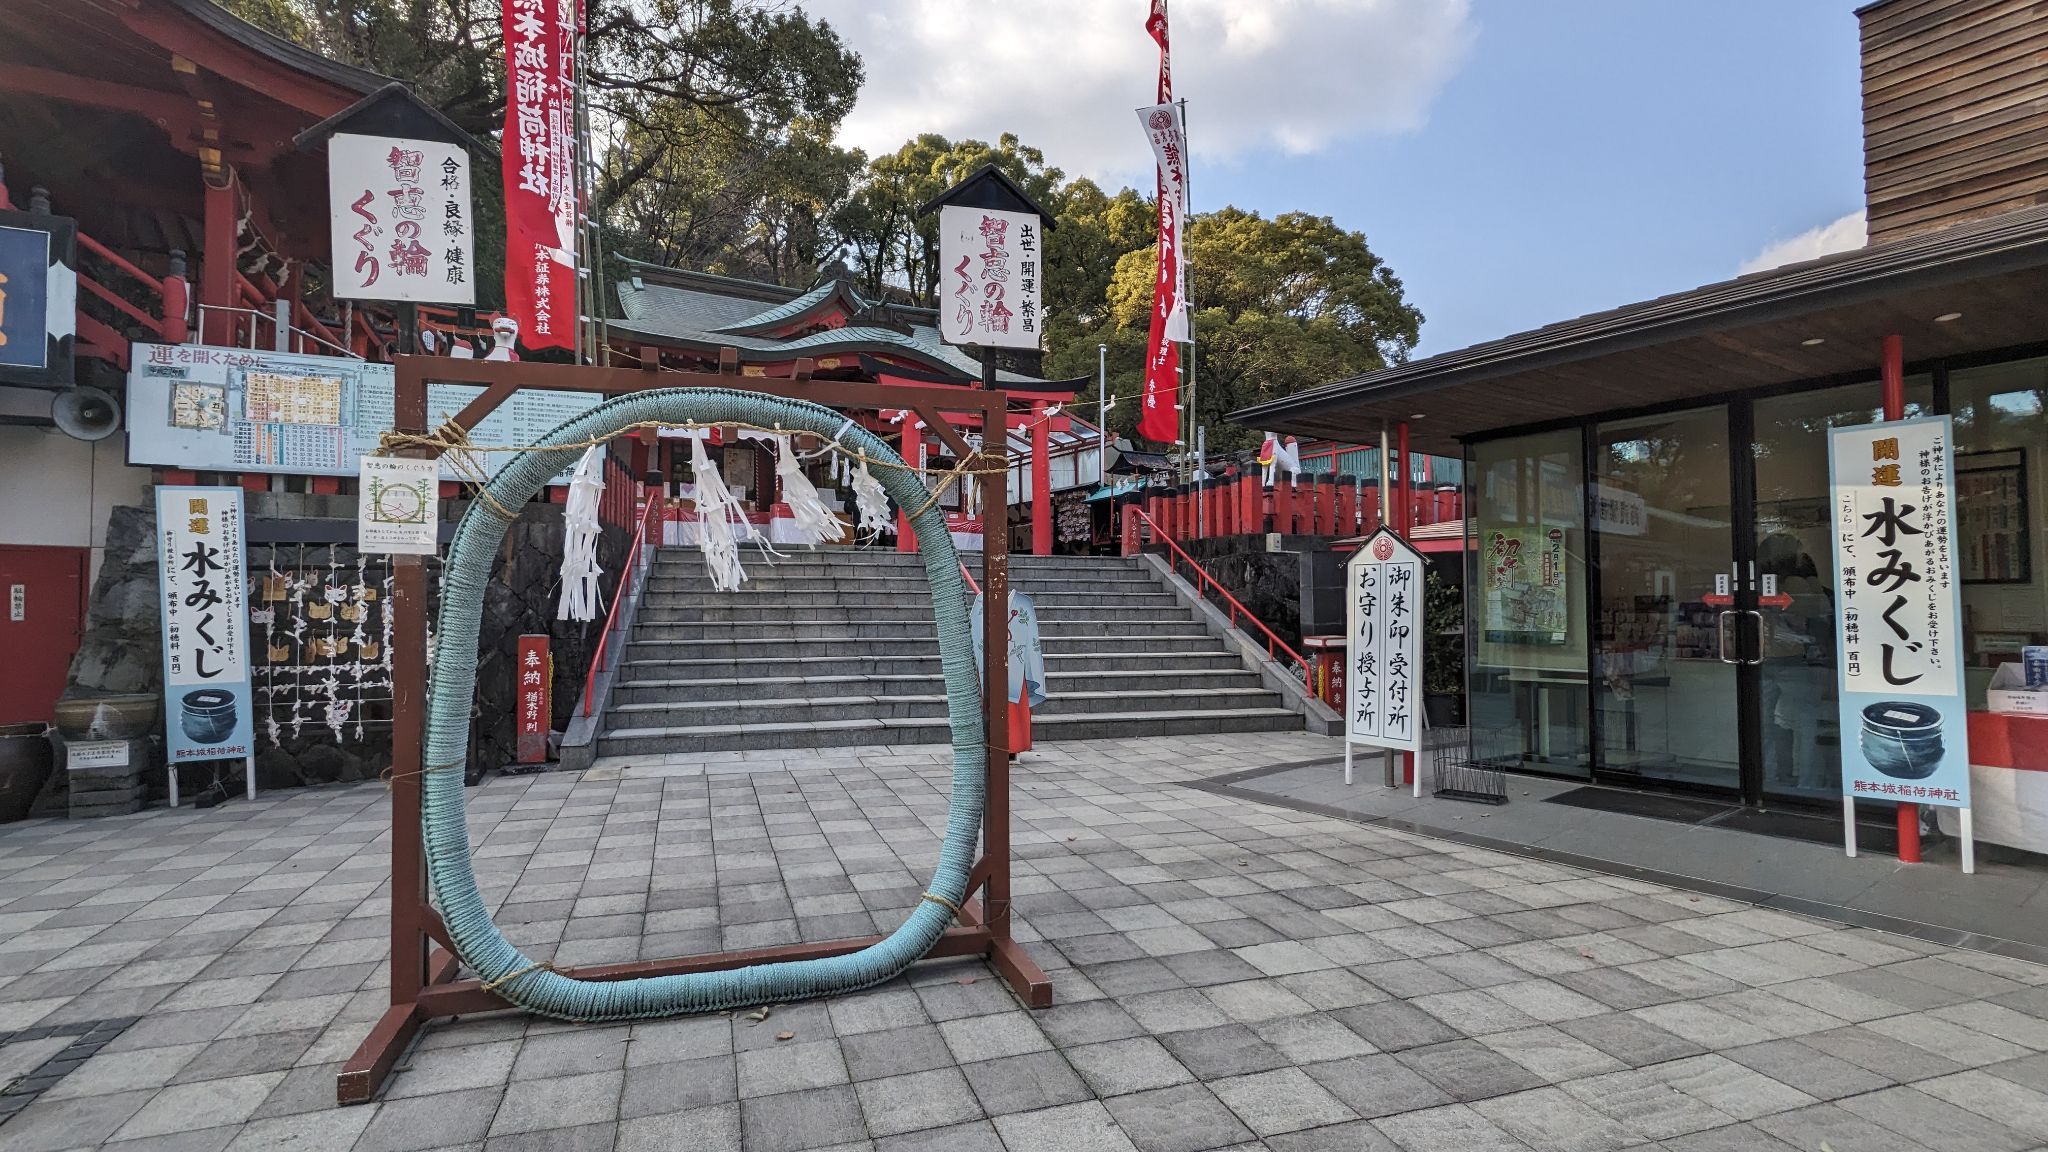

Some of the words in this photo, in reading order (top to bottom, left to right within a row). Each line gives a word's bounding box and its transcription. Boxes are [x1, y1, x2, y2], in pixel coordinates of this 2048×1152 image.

[351, 189, 384, 288] くぐり
[440, 156, 466, 286] 合格・良縁・健康
[954, 254, 978, 336] くぐり
[1019, 224, 1036, 333] 出世・開運・繁昌
[1871, 437, 1903, 487] 開運
[188, 497, 210, 535] 開運
[1932, 435, 1950, 589] ご神水によりあなたの運勢を占います
[181, 541, 225, 679] 水みくじ
[1861, 496, 1925, 686] 水みくじ
[523, 649, 541, 685] 奉納
[1331, 660, 1342, 688] 奉納
[1356, 567, 1378, 731] お守り授与所
[1387, 568, 1411, 735] 御朱印受付所
[175, 745, 247, 759] 熊本城稲荷神社
[1853, 779, 1960, 802] 熊本城稲荷神社
